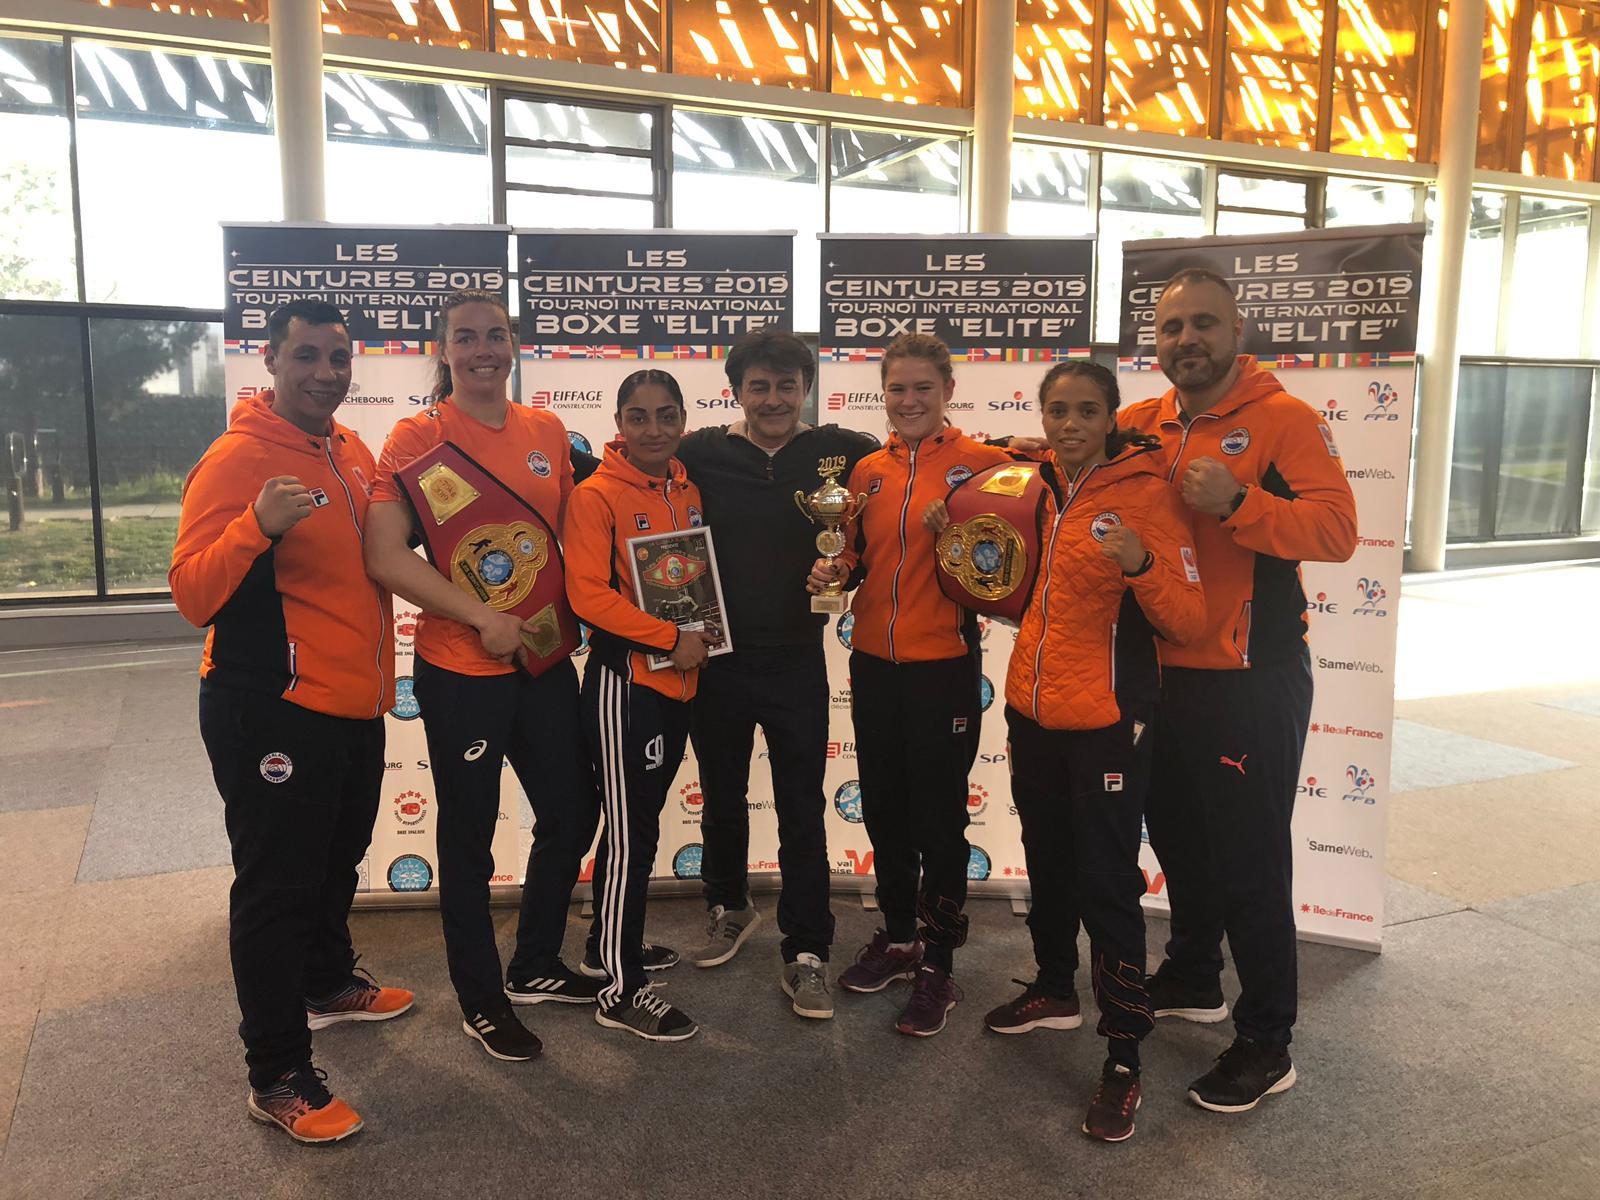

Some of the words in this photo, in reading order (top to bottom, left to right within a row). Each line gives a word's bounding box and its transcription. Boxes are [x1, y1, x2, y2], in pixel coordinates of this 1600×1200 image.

[336, 243, 399, 262] LES
[627, 249, 688, 268] LES
[926, 253, 986, 271] LES
[1234, 252, 1299, 274] LES
[427, 271, 504, 289] 2019
[714, 276, 789, 294] 2019
[1012, 280, 1087, 297] 2019
[1327, 276, 1413, 296] 2019
[335, 293, 448, 306] INTERNATI
[526, 298, 619, 311] TOURNOI
[626, 299, 785, 311] INTERNATIONAL
[827, 302, 917, 314] TOURNOI
[923, 302, 1082, 314] INTERNATIONAL
[535, 314, 640, 334] BOXE
[835, 317, 937, 337] BOXE
[949, 317, 1075, 338] "ELITE"
[1257, 318, 1399, 343] "ELITE"
[553, 390, 604, 402] EIFFAGE
[1364, 413, 1399, 421] FFB
[818, 455, 847, 470] 2019
[1306, 595, 1338, 614] PIE
[1353, 608, 1387, 617] FFB
[1342, 795, 1376, 805] FFB
